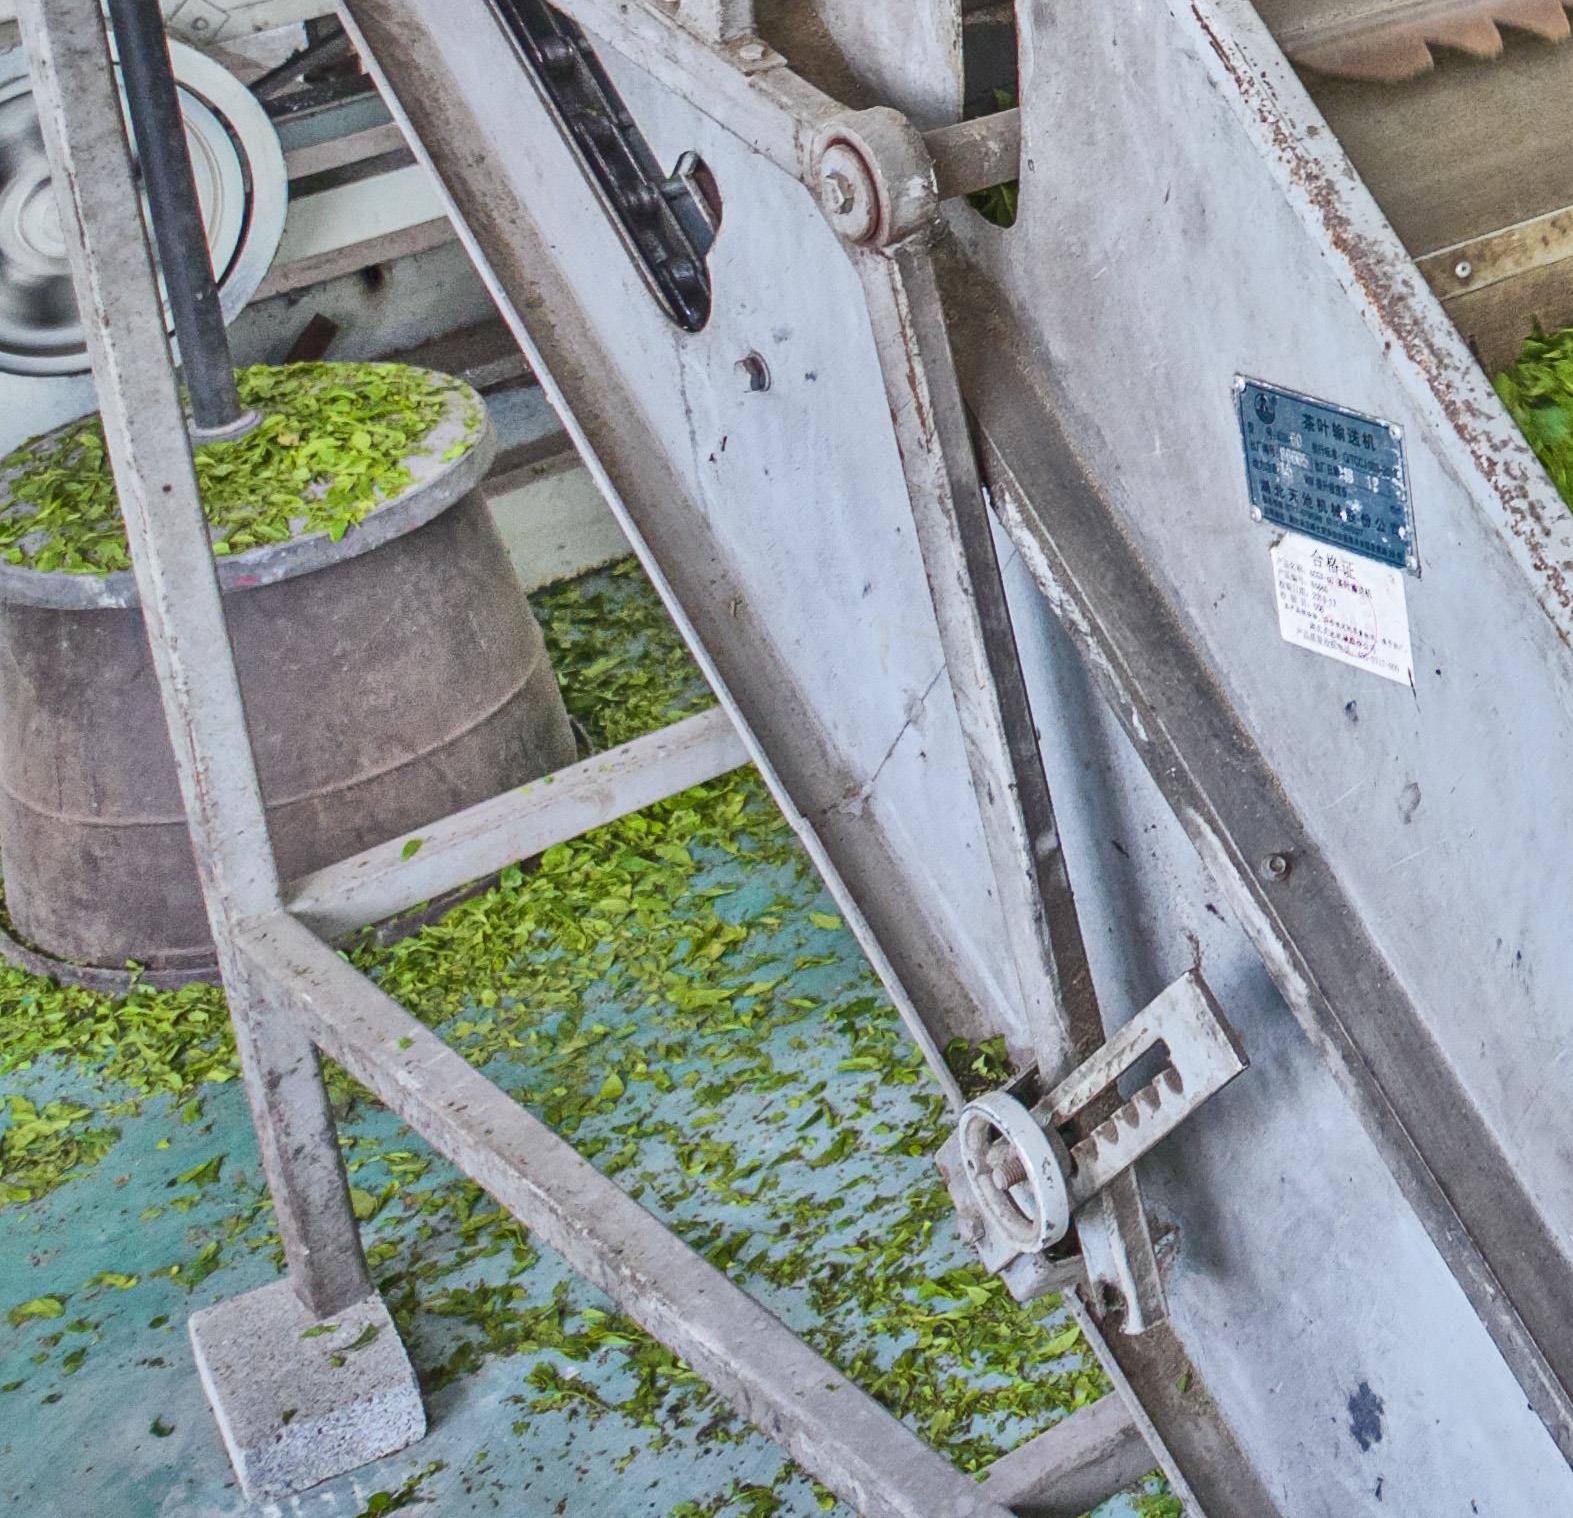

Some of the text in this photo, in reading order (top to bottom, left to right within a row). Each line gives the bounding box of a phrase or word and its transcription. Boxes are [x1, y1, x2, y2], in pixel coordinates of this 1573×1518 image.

[1302, 412, 1375, 452] 茶叶输送机
[1310, 547, 1355, 579] 合格证
